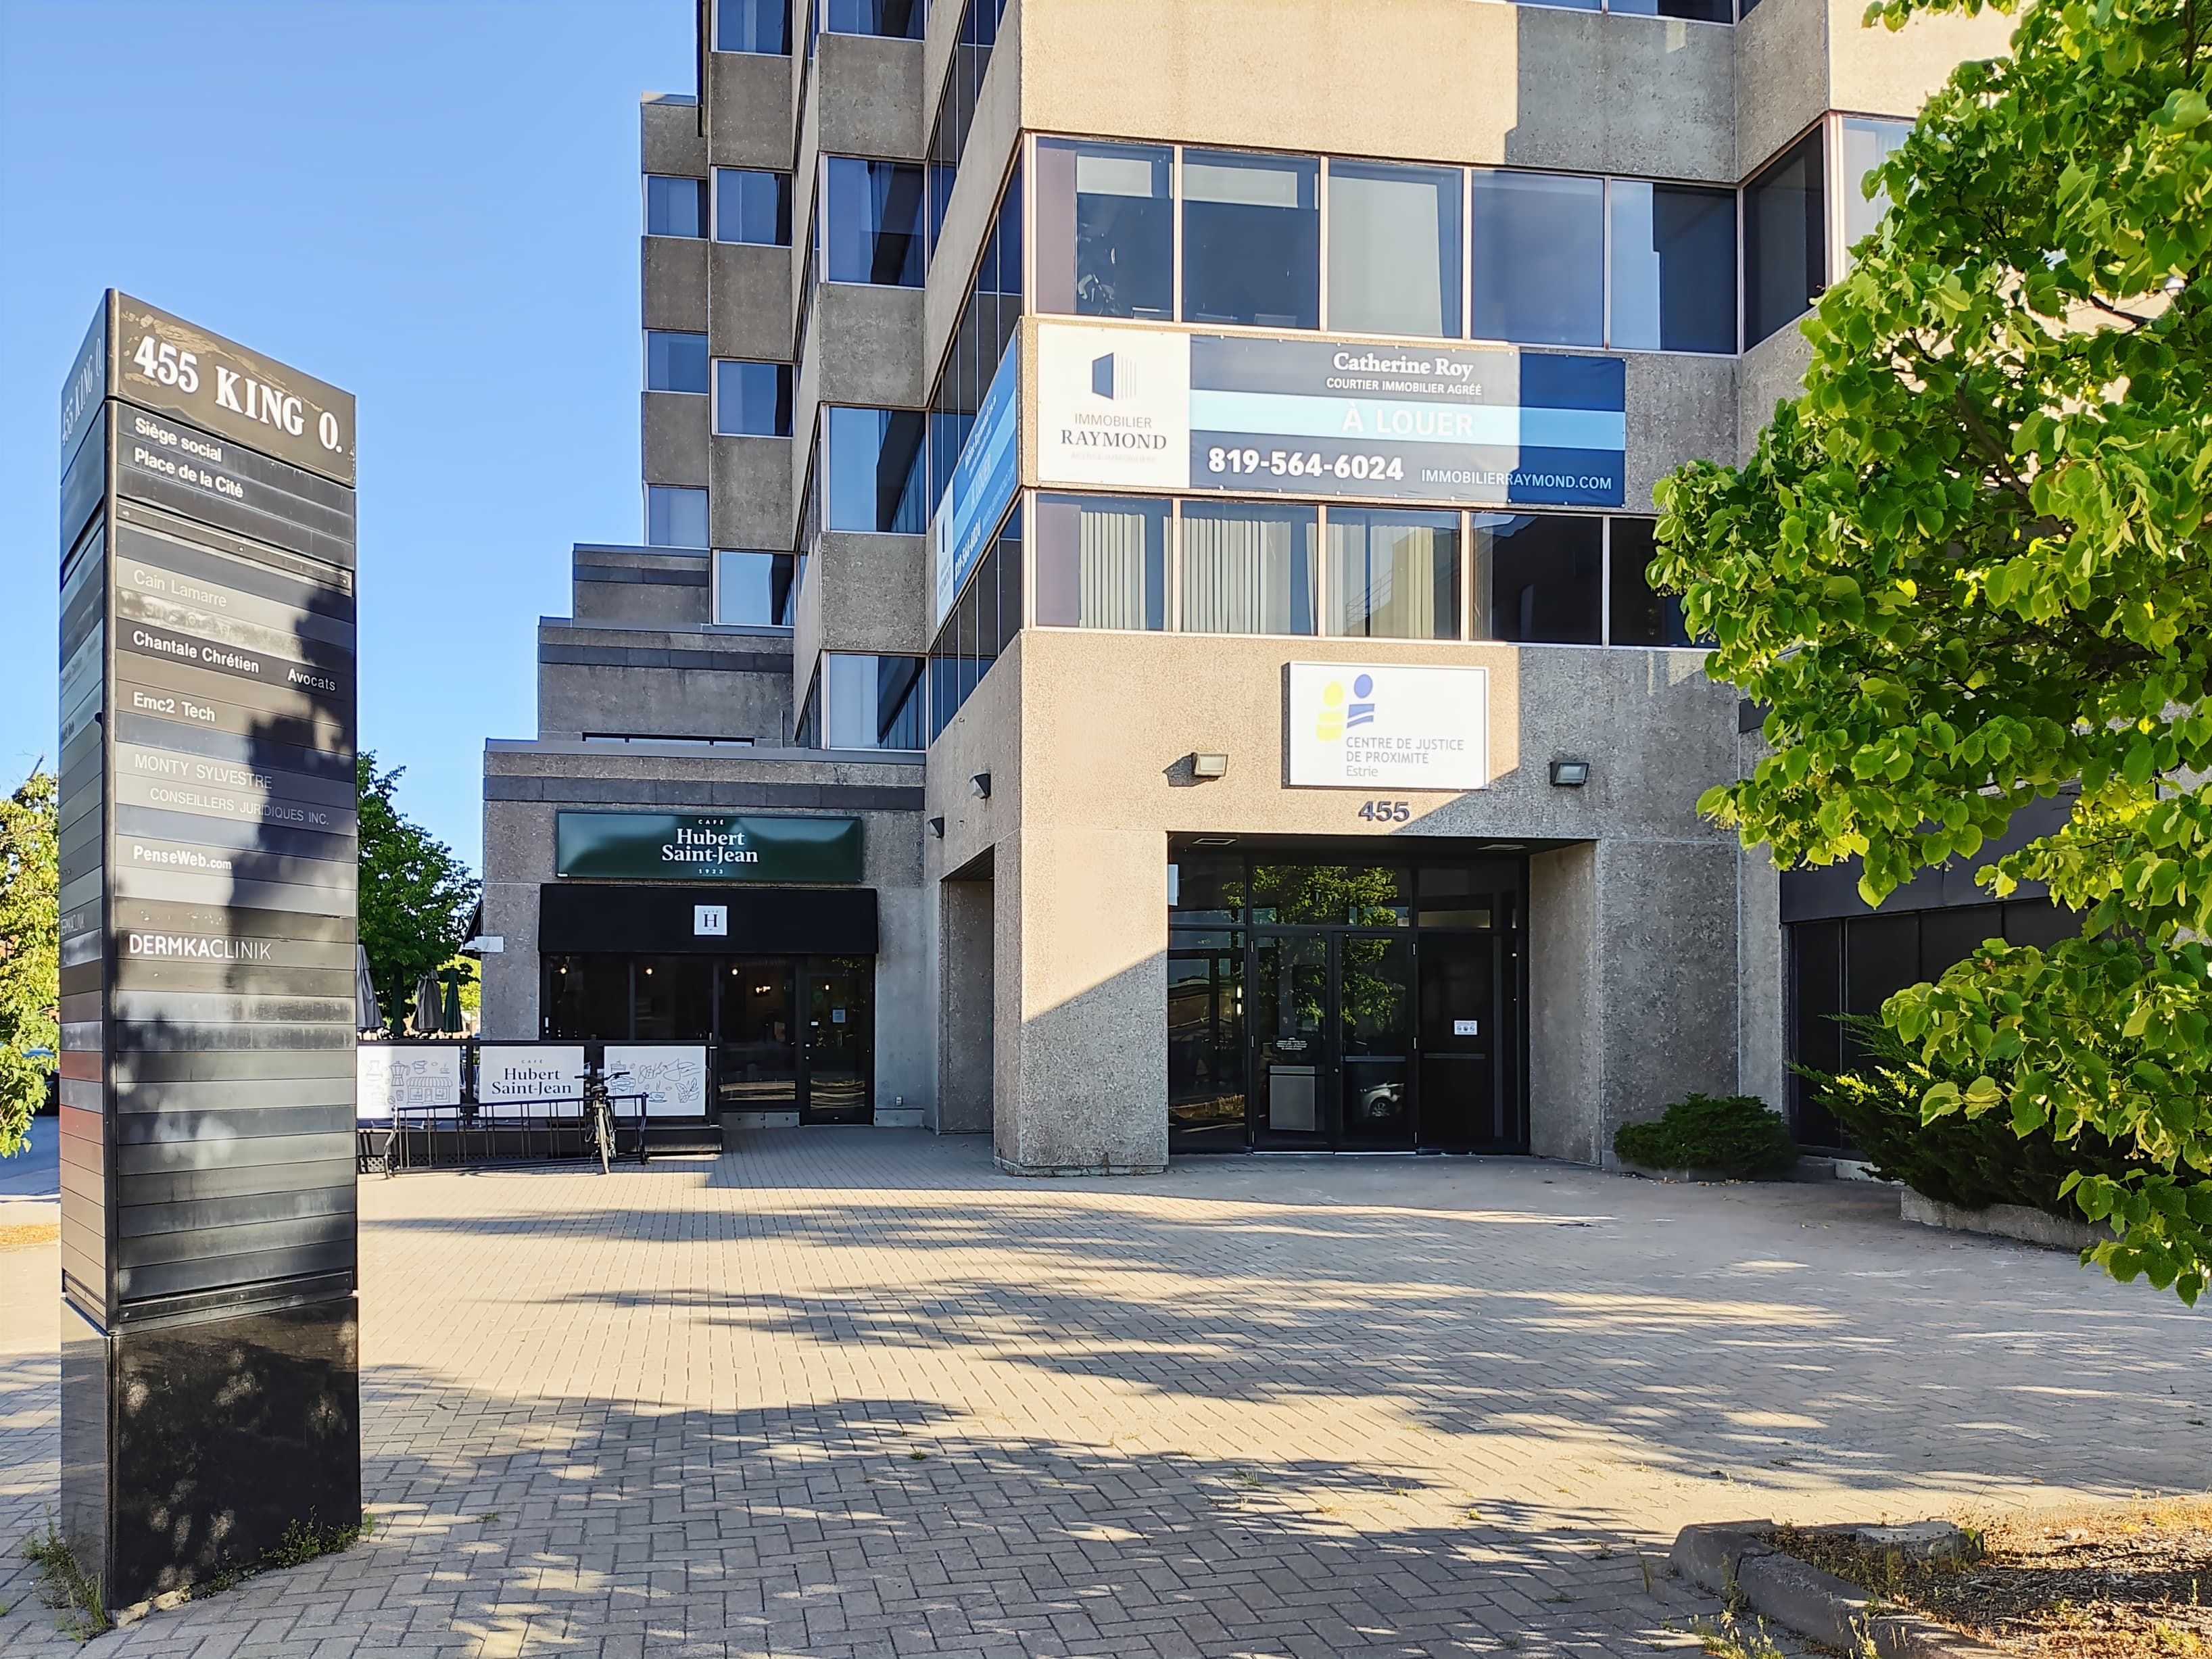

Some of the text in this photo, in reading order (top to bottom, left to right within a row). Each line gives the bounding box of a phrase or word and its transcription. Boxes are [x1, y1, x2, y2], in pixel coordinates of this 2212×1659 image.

[1333, 352, 1474, 382] Catherine Roy
[74, 354, 93, 423] KING
[133, 335, 343, 454] 455 KING O.
[1326, 377, 1482, 395] COURTIER IMMOBILIER AGRÉÉ
[1075, 412, 1152, 428] IMMOBILIER
[1342, 400, 1473, 437] À LOUER
[135, 417, 222, 462] Siège social
[1061, 429, 1167, 450] RAYMOND
[135, 446, 244, 499] Place de la Cité
[1208, 448, 1404, 481] 819-564-6024
[1421, 468, 1612, 490] IMMOBILIERRAYMOND.COM
[134, 569, 227, 608] Cain Lamarre
[133, 629, 336, 692] Chantale Chrétien Avocats
[134, 692, 216, 723] Emc2 Tech
[1346, 736, 1464, 750] CENTRE DE JUSTICE
[1346, 751, 1428, 764] DE PROXIMITÉ
[1346, 765, 1379, 777] Estrie
[135, 754, 272, 790] MONTY SYLVESTRE
[150, 788, 329, 825] CONSEILLERS JURIDIQUES INC.
[1358, 800, 1410, 822] 455
[676, 827, 746, 846] Hubert
[133, 844, 232, 871] PenseWeb.com
[662, 844, 759, 865] Saint-Jean
[704, 913, 718, 928] H
[128, 933, 272, 961] DERMKACLINIK
[504, 1067, 561, 1080] Hubert
[491, 1081, 571, 1096] Saint-Jean
